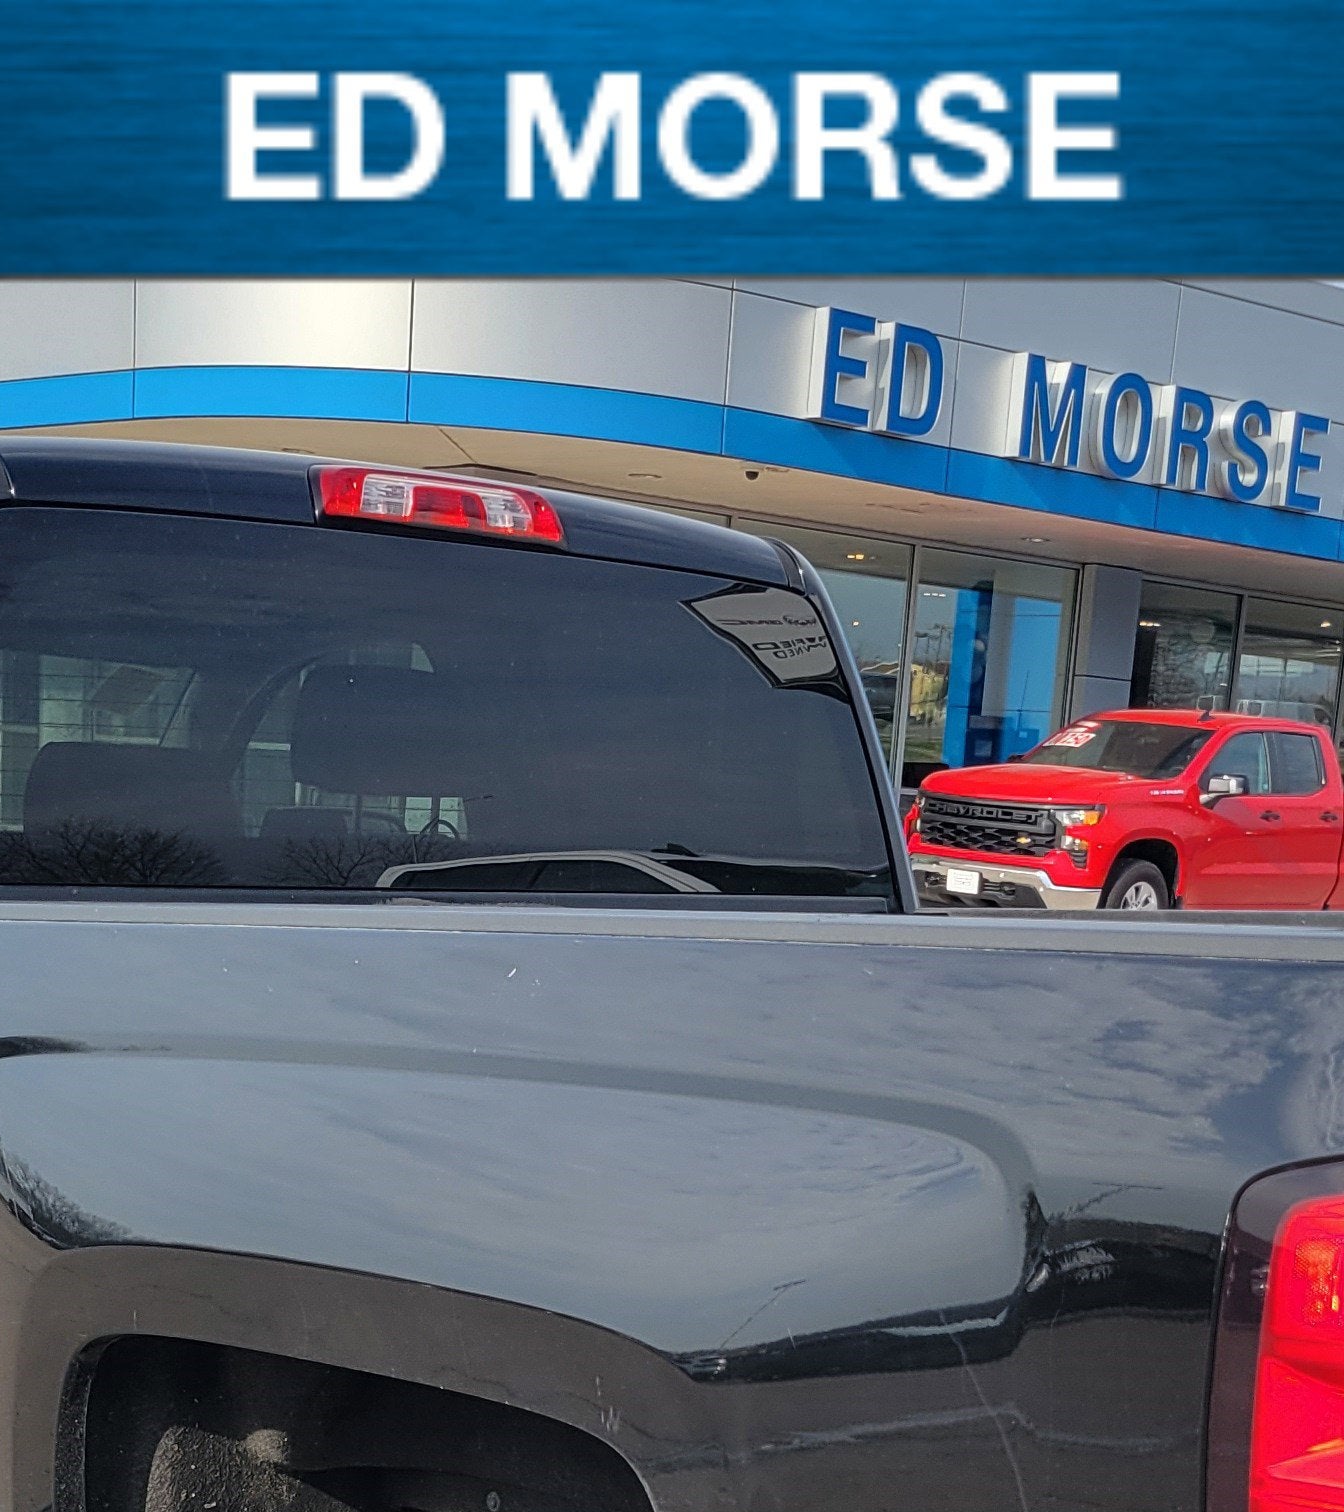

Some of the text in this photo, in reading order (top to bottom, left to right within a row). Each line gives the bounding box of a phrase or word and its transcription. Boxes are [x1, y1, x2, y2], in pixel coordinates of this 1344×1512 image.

[818, 305, 1331, 512] ED MORSE
[927, 801, 1041, 824] CHEVROLET
